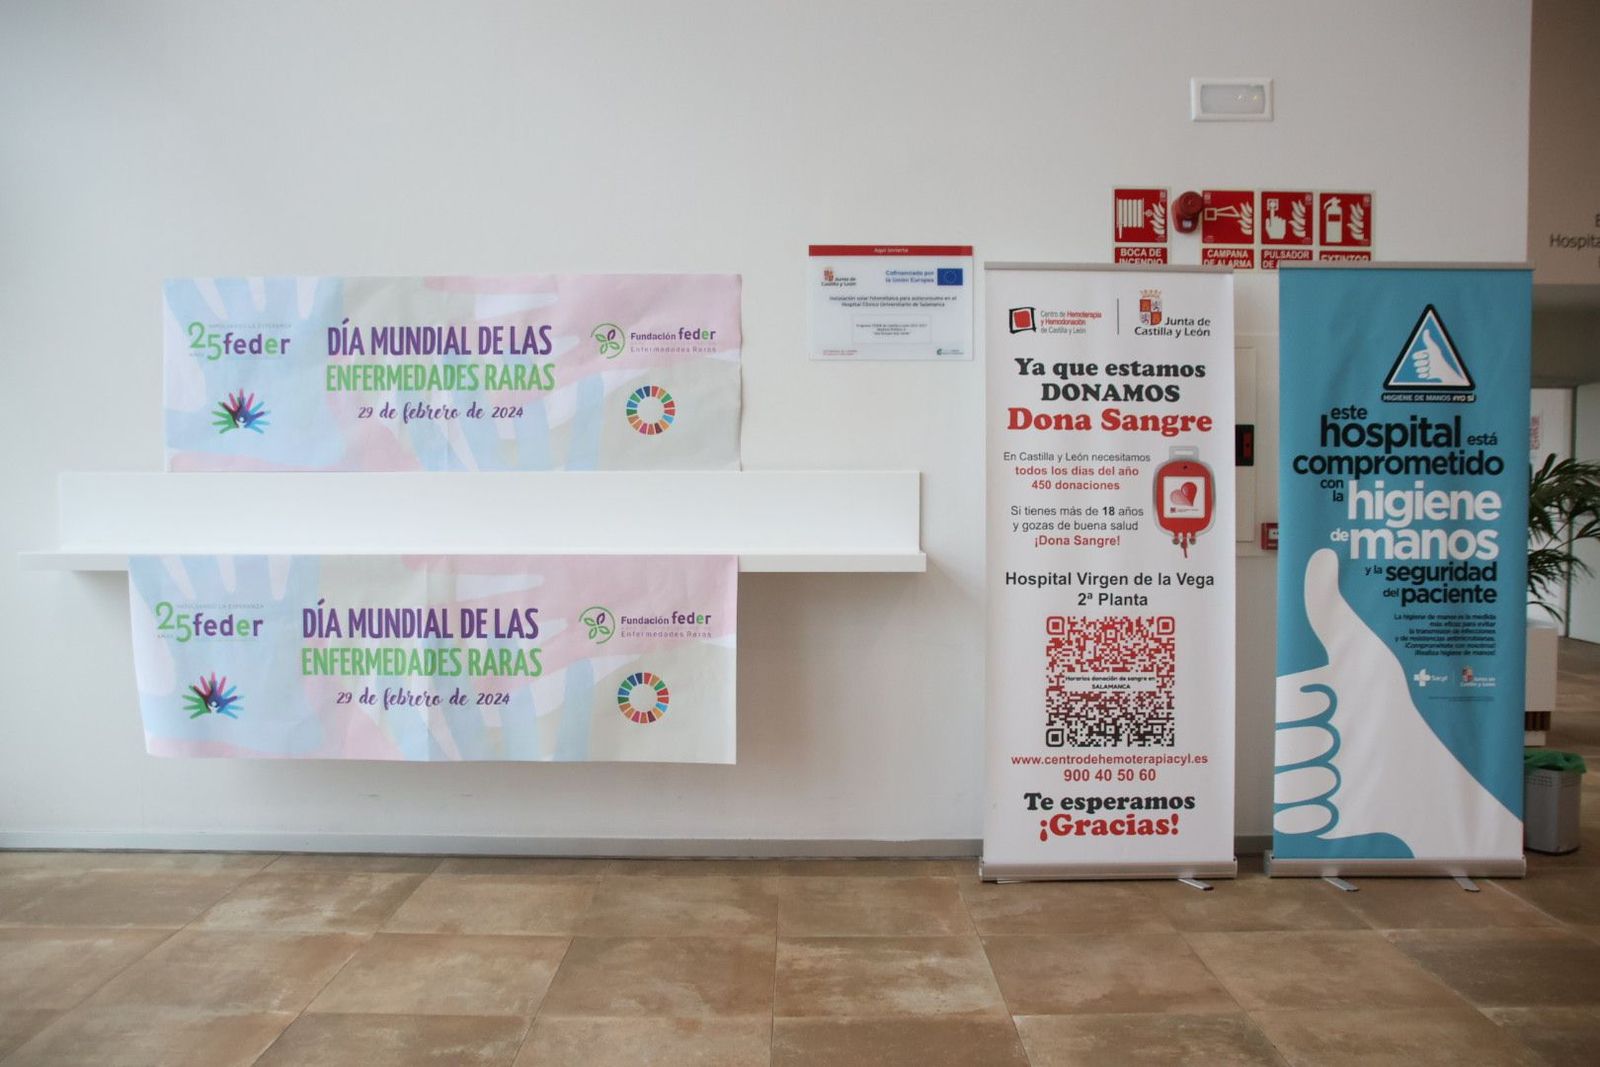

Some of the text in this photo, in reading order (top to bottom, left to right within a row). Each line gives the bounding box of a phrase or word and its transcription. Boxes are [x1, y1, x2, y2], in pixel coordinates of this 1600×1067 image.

[1549, 233, 1600, 251] Hospita
[1120, 248, 1162, 257] BOCA DE
[1207, 249, 1248, 258] CAMPANA
[1263, 250, 1309, 259] PULSADOR
[1217, 259, 1252, 268] ALARMA
[1262, 260, 1274, 268] DE
[1040, 310, 1102, 319] Centro de Hemoterapia
[1165, 316, 1211, 326] Junta de
[327, 318, 553, 356] DÍA MUNDIAL DE LAS
[630, 327, 716, 340] Fundación feder
[1134, 326, 1211, 338] Castilla y León
[188, 321, 223, 361] 25
[223, 332, 291, 355] feder
[326, 363, 556, 392] ENFERMEDADES RARAS
[1014, 358, 1206, 380] Ya que estamos
[1041, 383, 1181, 402] DONAMOS
[358, 401, 524, 424] 29 de febrero de 2024
[1330, 405, 1368, 420] este
[1007, 407, 1213, 437] Dona Sangre
[1320, 415, 1498, 454] hospital está
[1003, 451, 1151, 464] En Castilla y León necesitamos
[1293, 450, 1505, 480] comprometido
[1015, 467, 1139, 477] todos los días del año
[1031, 480, 1121, 490] 450 donaciones
[1320, 479, 1344, 489] con
[1010, 506, 1144, 517] Si tienes más de 18 años
[1332, 480, 1502, 528] la higiene
[1012, 521, 1139, 533] y gozas de buena salud
[1034, 535, 1121, 548] ¡Dona Sangre!
[1330, 528, 1500, 561] de manos
[1005, 572, 1215, 588] Hospital Virgen de la Vega
[1365, 561, 1498, 586] y la seguridad
[1077, 592, 1148, 606] 2ª Planta
[1382, 584, 1498, 607] del paciente
[155, 601, 192, 643] 25
[192, 612, 264, 637] feder
[302, 598, 540, 640] DÍA MUNDIAL DE LAS
[620, 611, 712, 625] Fundación feder
[301, 647, 543, 677] ENFERMEDADES RARAS
[336, 687, 511, 711] 29 de febrero de 2024
[1011, 753, 1208, 766] www.centrodehemoterapiacyl.es
[1063, 769, 1156, 782] 900 40 50 60
[1023, 792, 1196, 814] Te esperamos
[1039, 813, 1179, 842] ¡Gracias!
